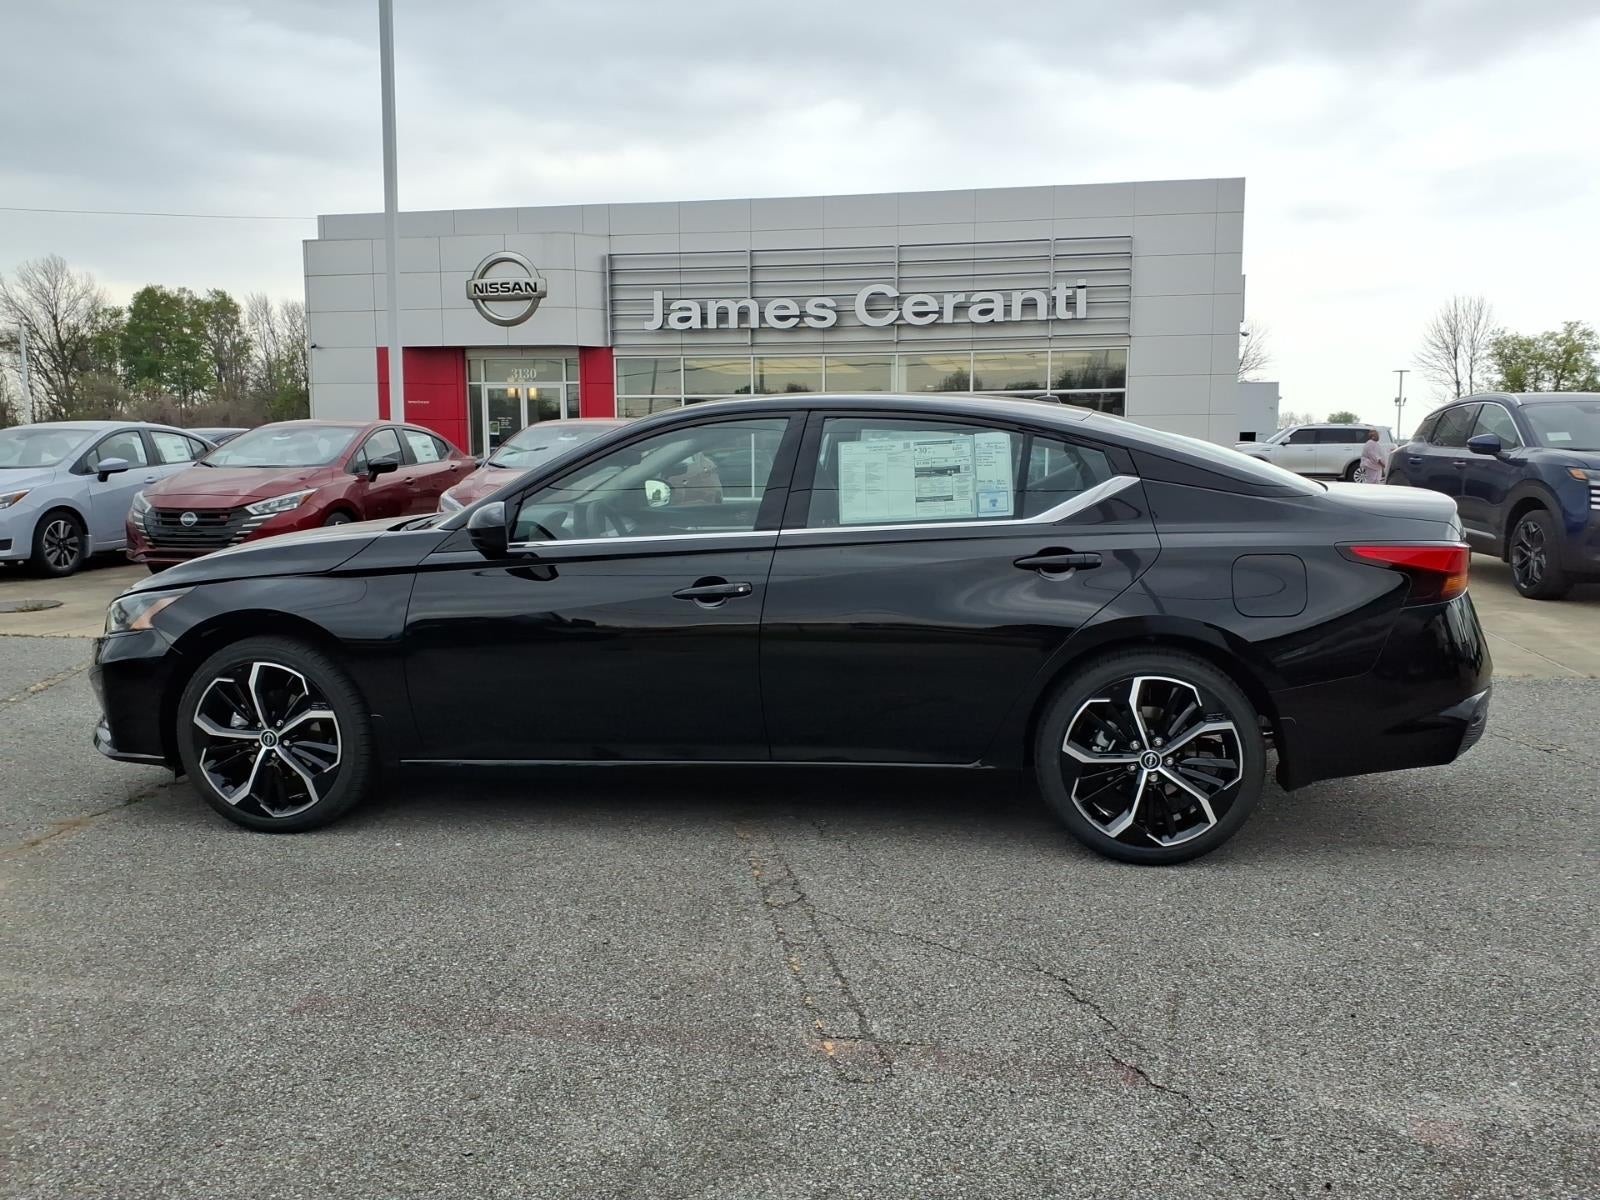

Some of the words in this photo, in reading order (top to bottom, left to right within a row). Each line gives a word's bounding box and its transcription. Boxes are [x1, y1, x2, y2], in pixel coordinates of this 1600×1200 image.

[473, 281, 538, 295] NISSAN
[644, 289, 838, 330] James
[854, 278, 1087, 327] Ceranti
[511, 368, 537, 379] 3130
